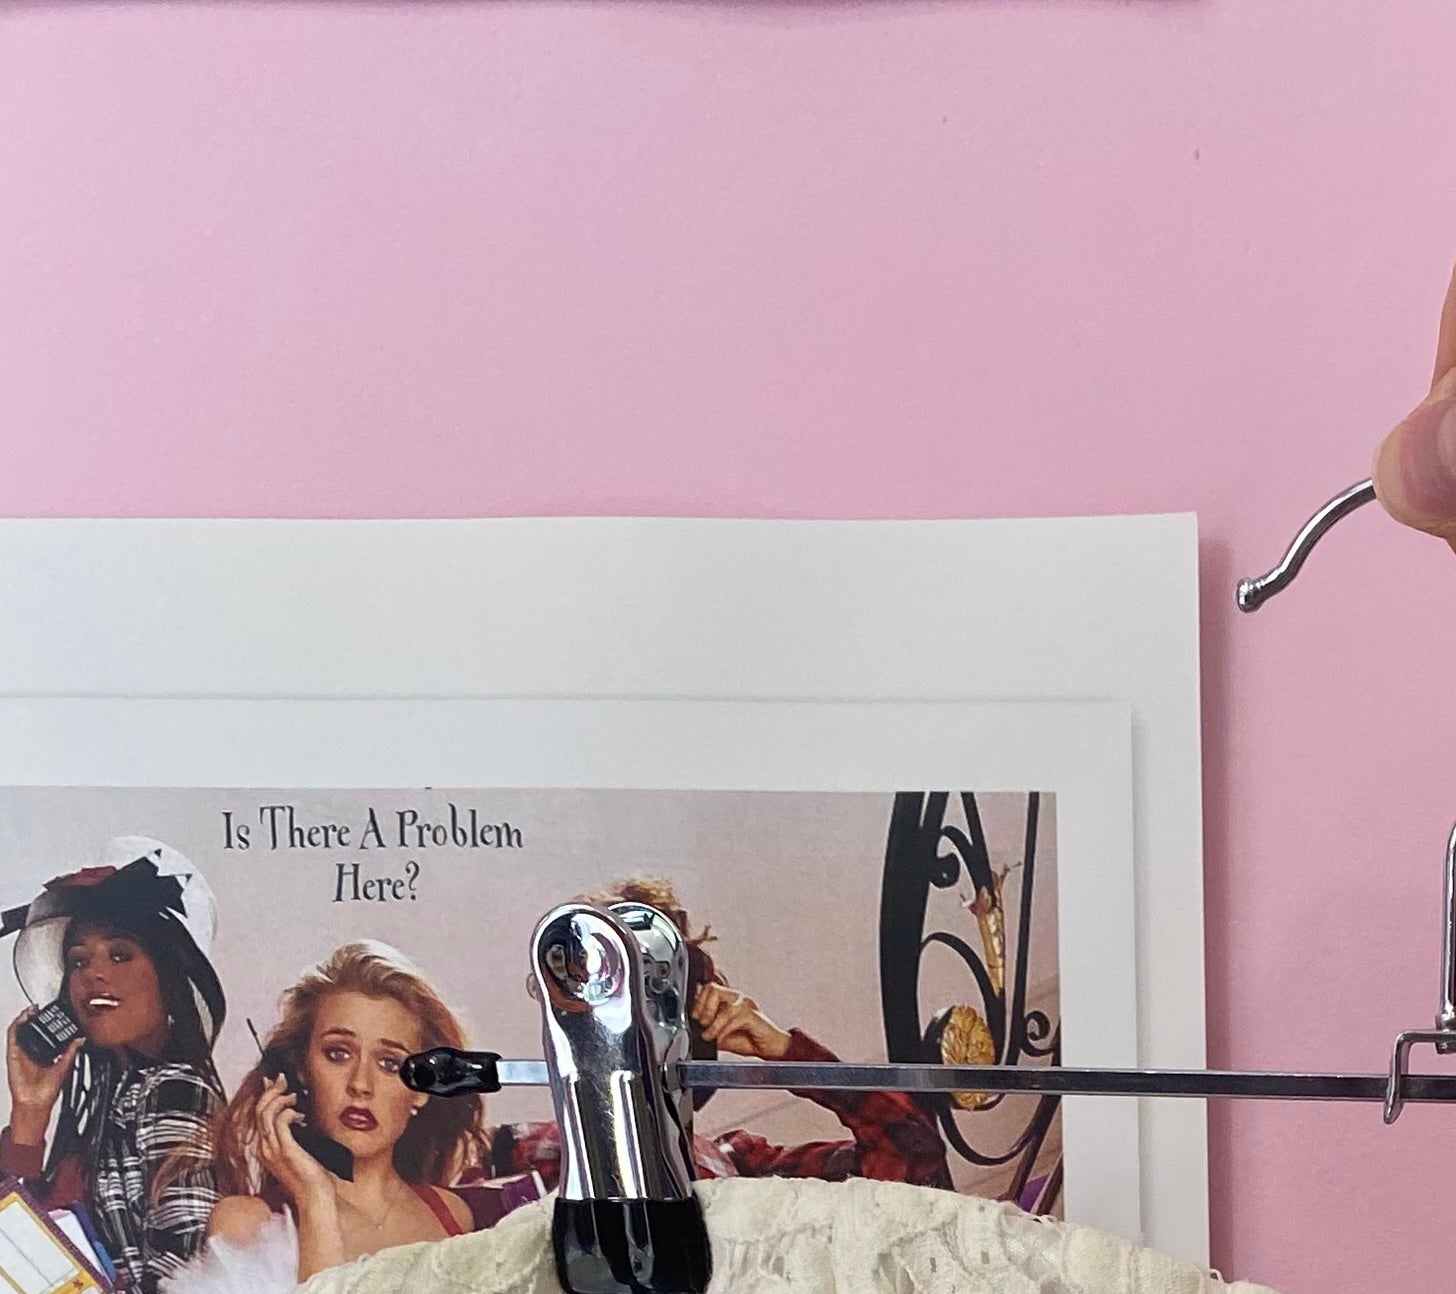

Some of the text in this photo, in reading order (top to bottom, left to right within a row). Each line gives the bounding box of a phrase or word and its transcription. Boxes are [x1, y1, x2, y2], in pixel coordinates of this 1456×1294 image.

[222, 802, 523, 850] Is There A Problem
[333, 860, 420, 903] Here?
